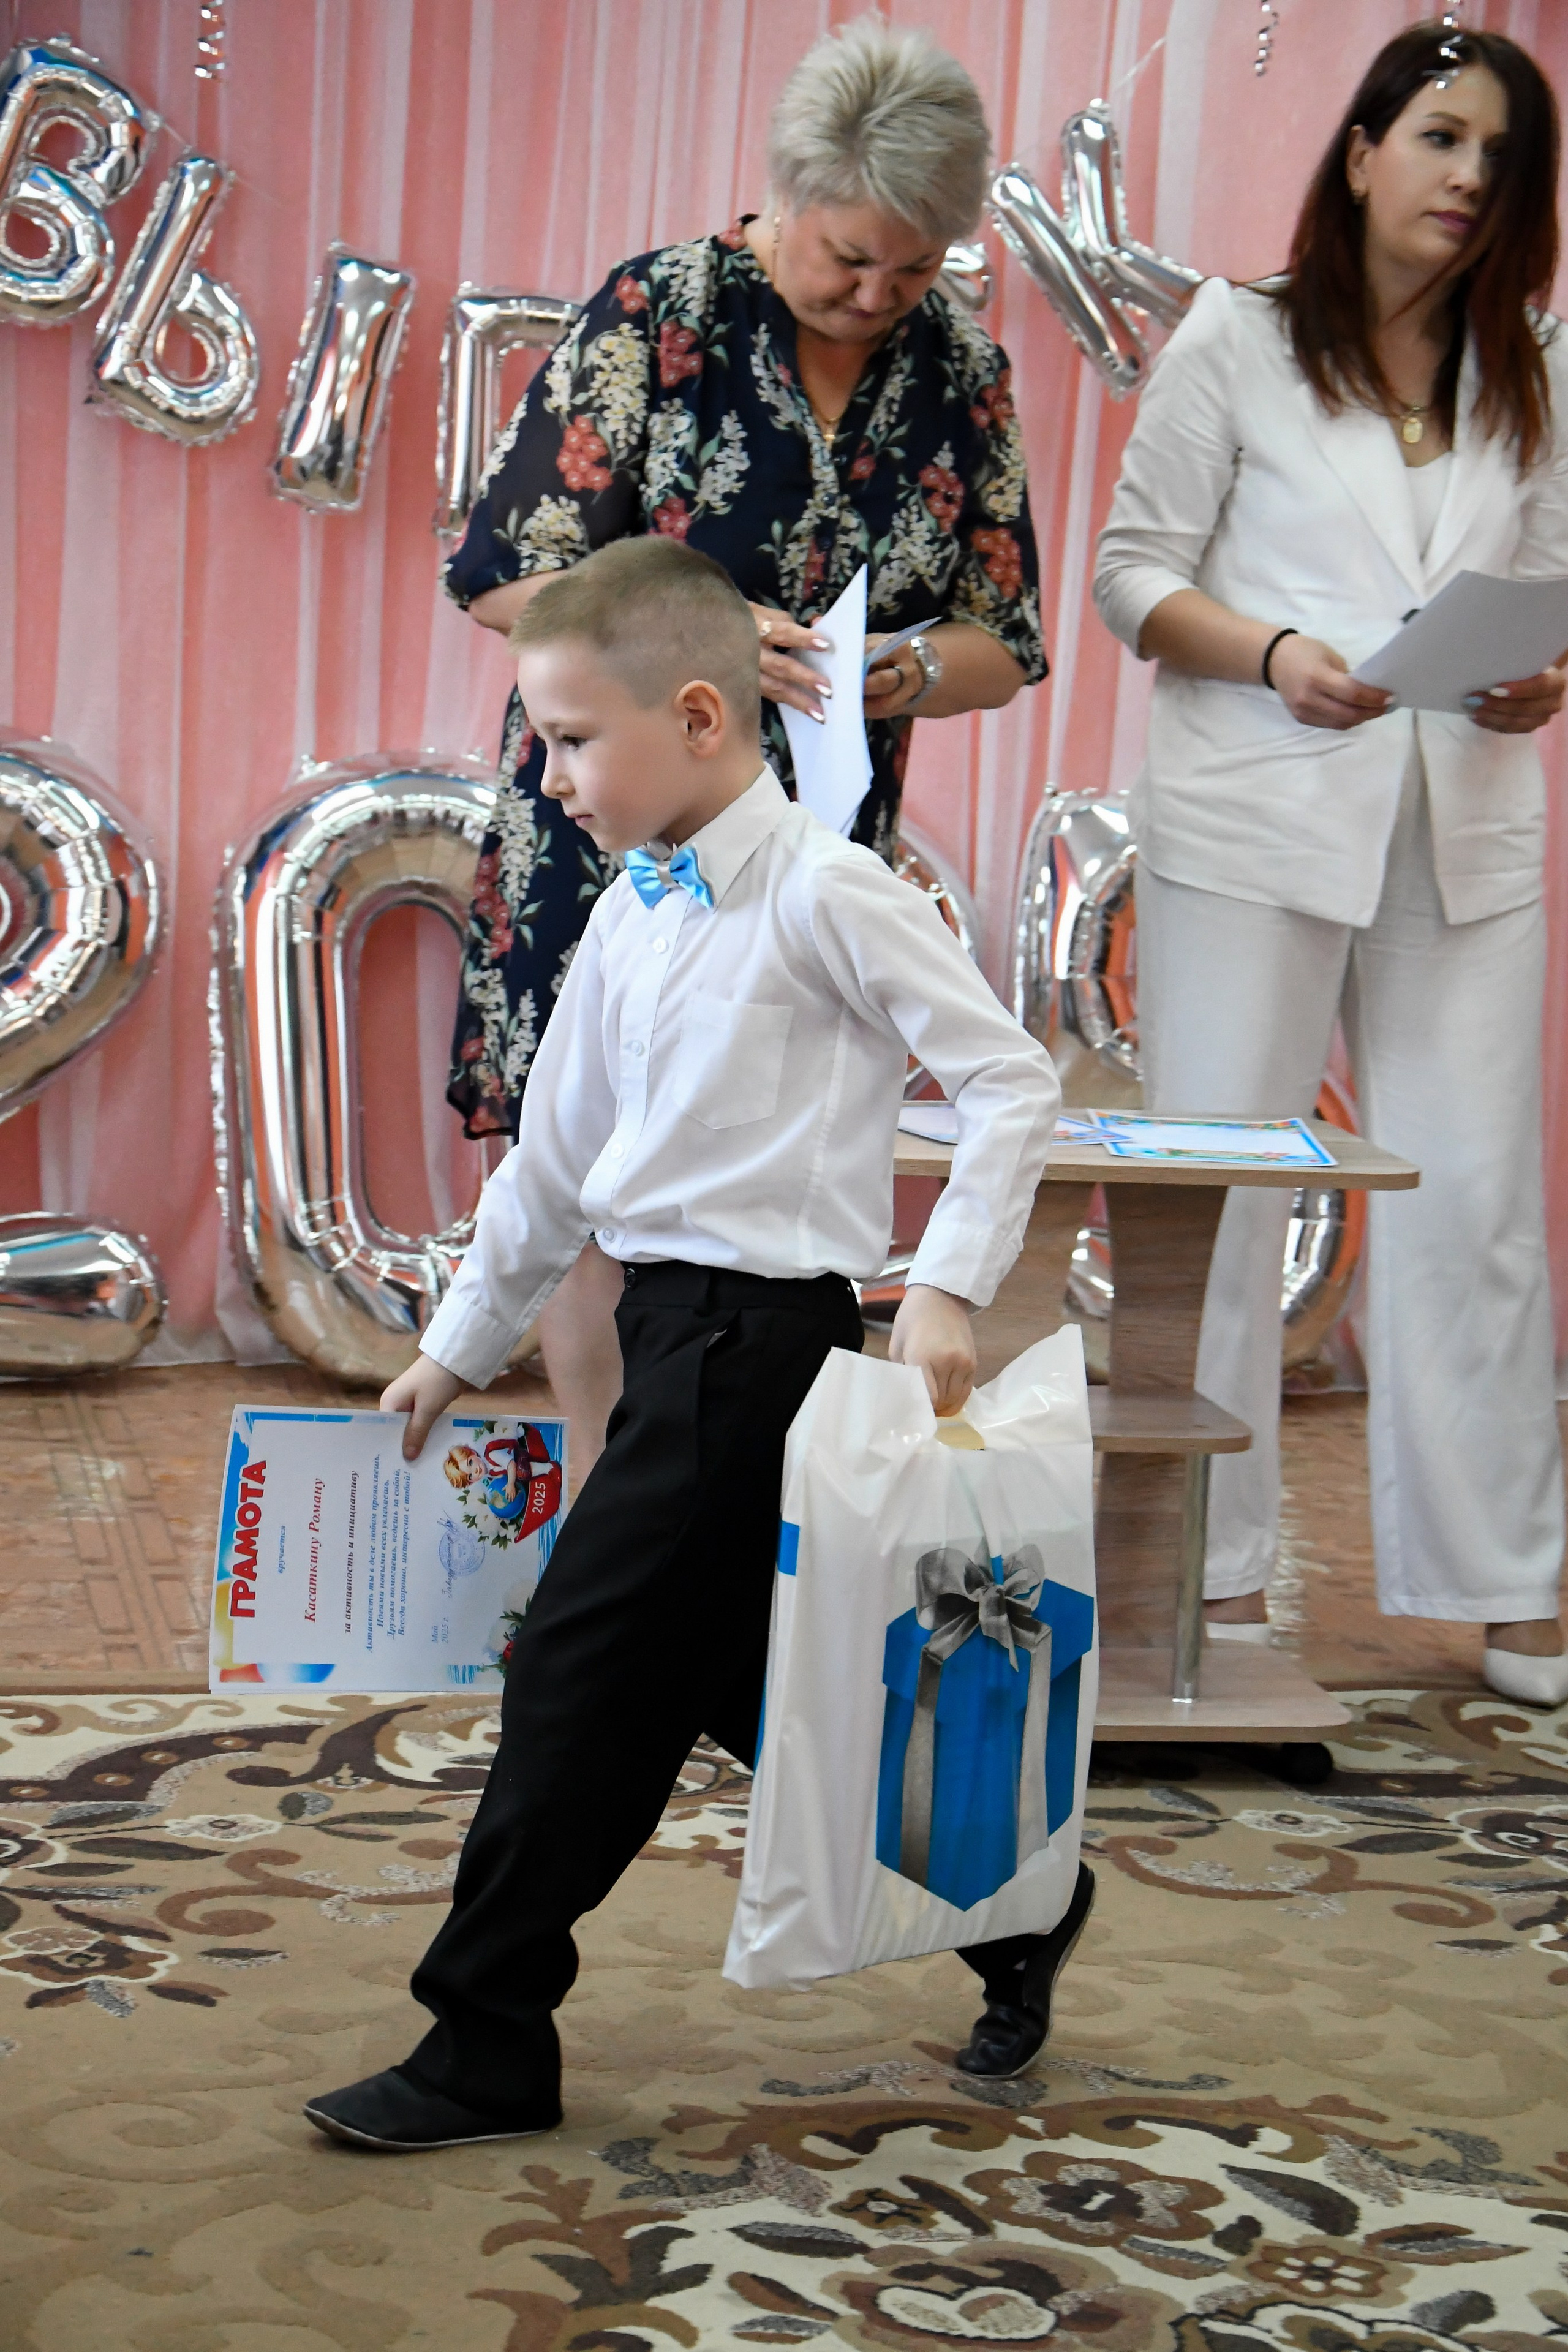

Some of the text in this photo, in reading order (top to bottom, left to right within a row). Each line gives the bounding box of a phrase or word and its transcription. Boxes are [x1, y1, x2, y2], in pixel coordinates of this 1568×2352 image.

[230, 1460, 266, 1618] ГРАМОТА
[277, 1525, 286, 1574] вручается
[304, 1477, 325, 1622] Касаткину Роману
[345, 1623, 351, 1634] за
[349, 1470, 359, 1539] инициативу
[532, 1481, 546, 1515] 2025
[369, 1575, 374, 1591] ты
[387, 1600, 396, 1640] Друзьям
[394, 1499, 399, 1508] за
